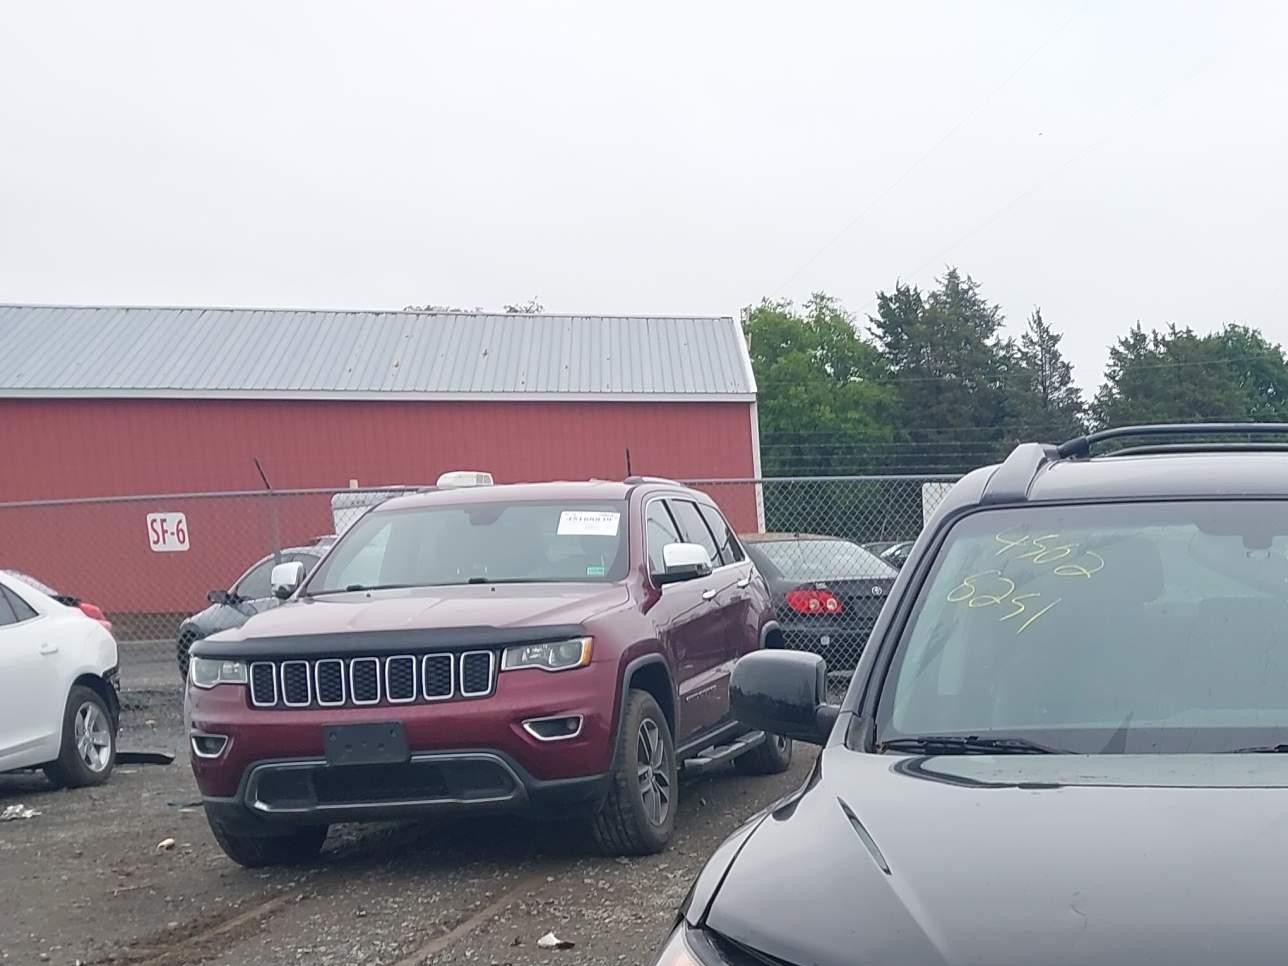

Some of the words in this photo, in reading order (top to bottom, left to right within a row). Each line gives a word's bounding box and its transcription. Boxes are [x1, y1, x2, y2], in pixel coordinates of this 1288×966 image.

[150, 518, 185, 545] SF-6
[995, 534, 1105, 578] 4502
[947, 569, 1063, 635] 8251
